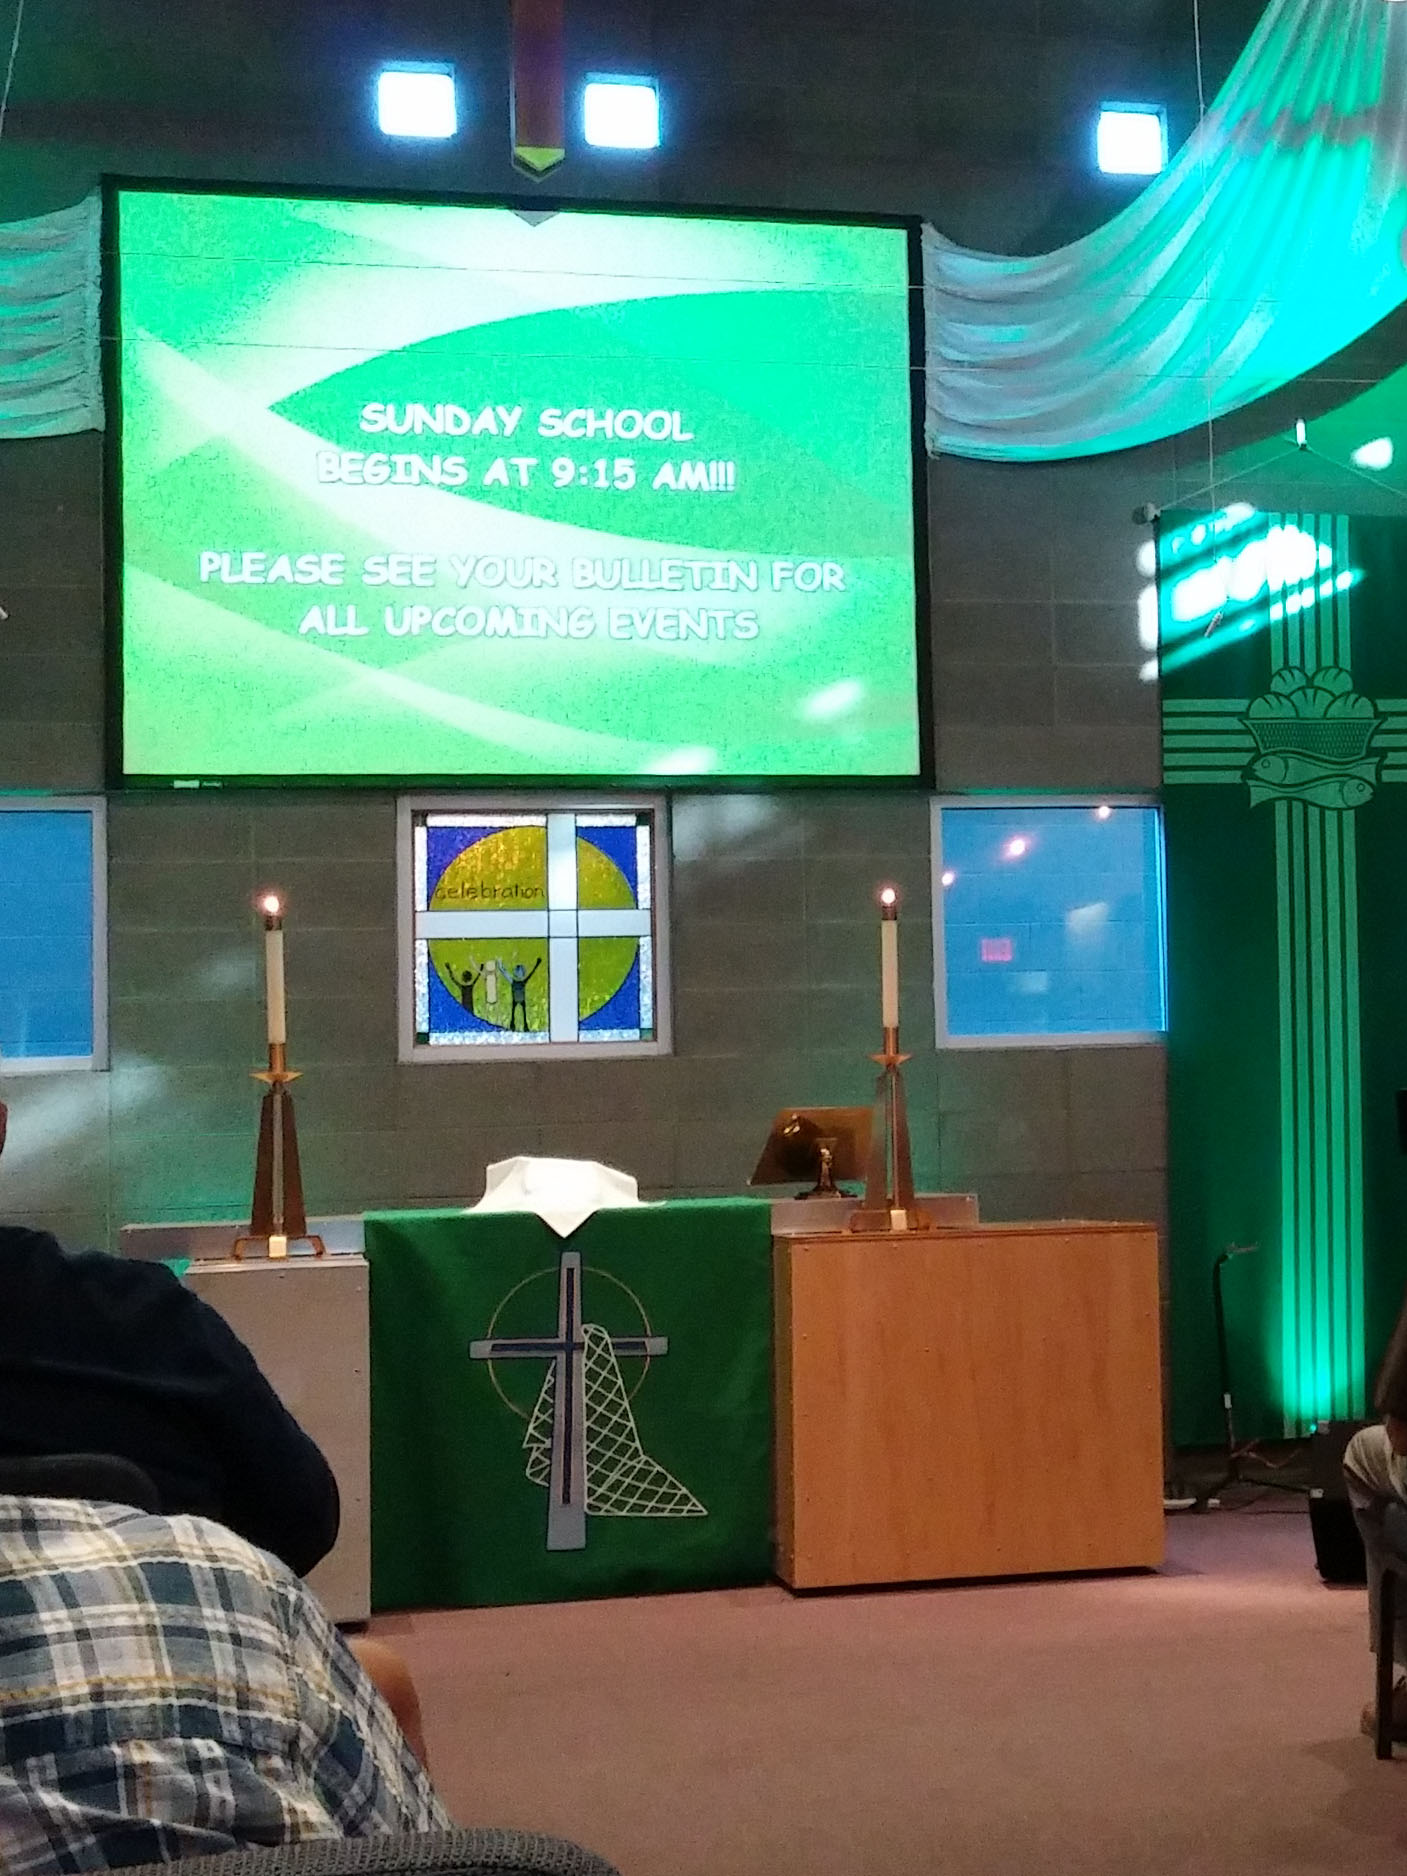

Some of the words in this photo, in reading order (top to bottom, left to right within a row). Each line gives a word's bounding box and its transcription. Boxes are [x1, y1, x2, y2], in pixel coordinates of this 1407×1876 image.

[359, 402, 523, 437] SUNDAY
[537, 408, 695, 441] SCHOOL
[316, 451, 469, 486] BEGINS
[482, 457, 539, 487] AT
[551, 457, 636, 491] 9:15
[652, 460, 736, 492] AM!!!
[200, 551, 345, 585] PLEASE
[362, 554, 437, 587] SEE
[450, 556, 558, 588] YOUR
[572, 558, 758, 592] BULLETIN
[771, 561, 847, 592] FOR
[299, 605, 369, 636] ALL
[384, 605, 596, 639] UPCOMING
[608, 608, 760, 640] EVENTS
